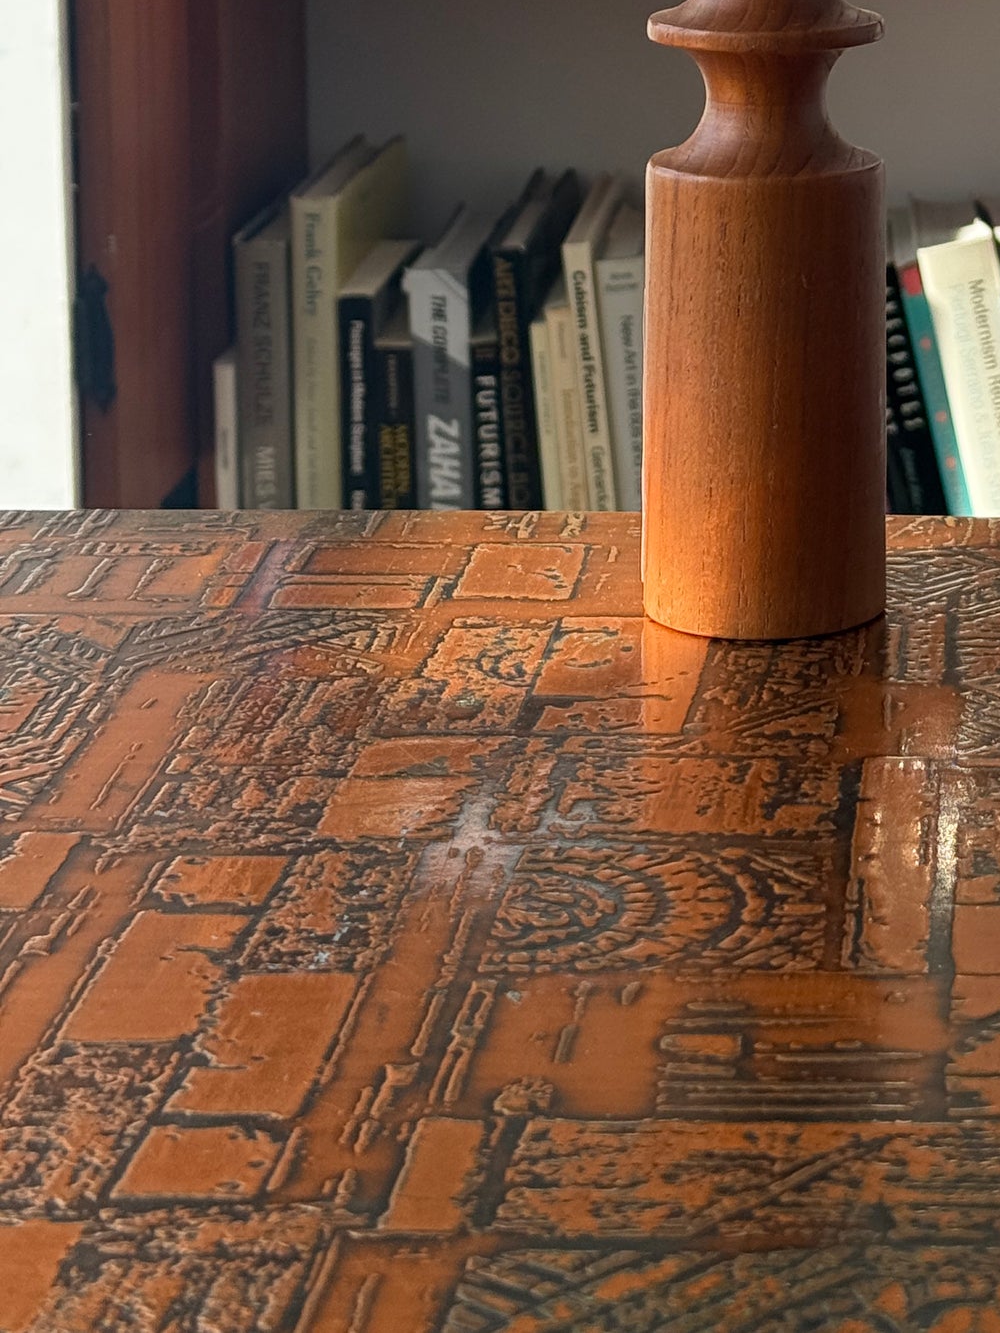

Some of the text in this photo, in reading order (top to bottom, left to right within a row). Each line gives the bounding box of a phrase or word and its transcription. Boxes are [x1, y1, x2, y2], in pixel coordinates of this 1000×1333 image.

[304, 212, 322, 259] Frank
[303, 265, 324, 316] Gehry
[431, 294, 446, 323] THE
[967, 278, 998, 370] Modernism
[499, 300, 519, 365] DECO
[573, 270, 602, 434] Cubism and Futurism
[426, 413, 461, 499] ZAHA
[475, 375, 502, 507] FUTURISM
